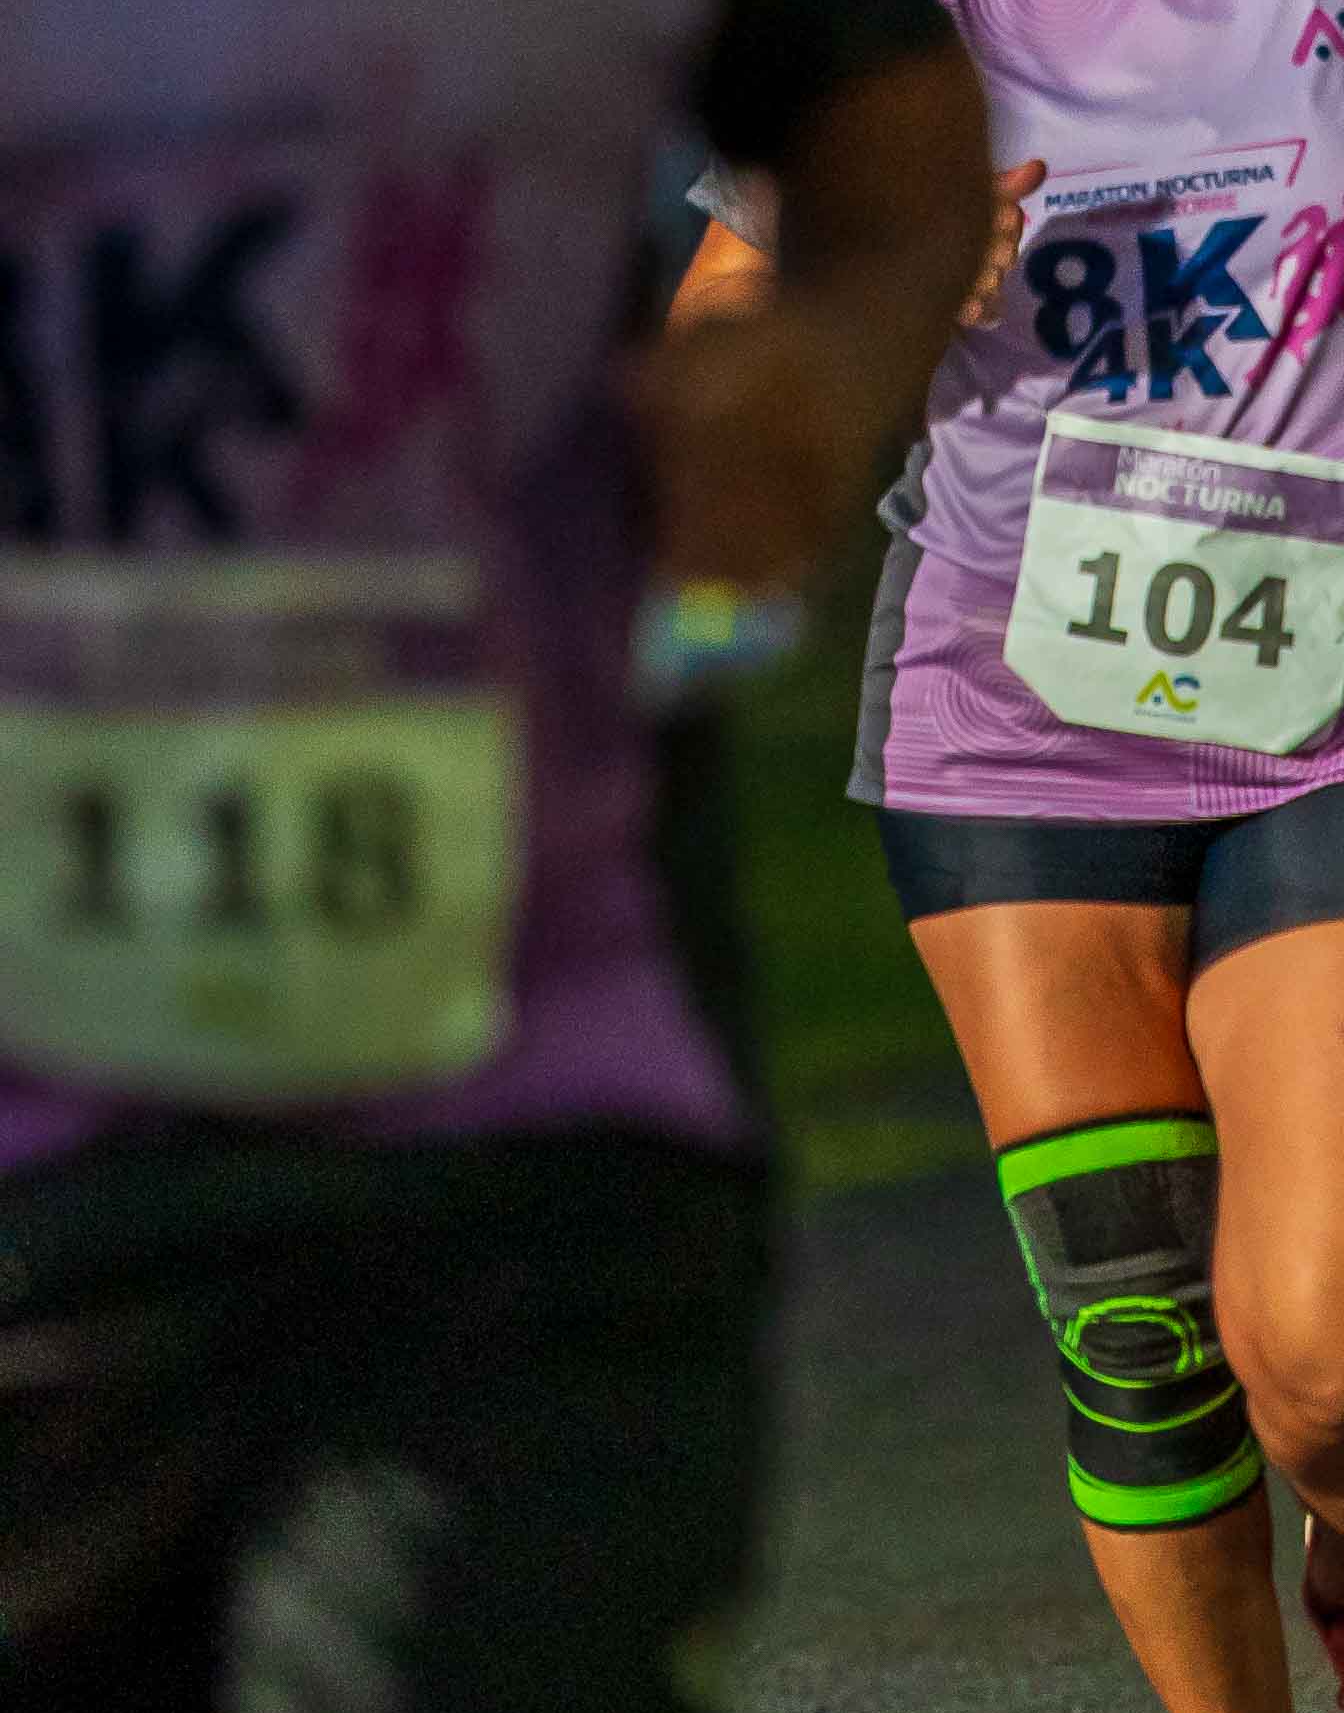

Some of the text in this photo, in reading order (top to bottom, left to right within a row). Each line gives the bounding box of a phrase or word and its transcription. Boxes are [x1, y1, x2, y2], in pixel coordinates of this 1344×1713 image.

[1024, 212, 1273, 361] 8K
[1067, 310, 1234, 403] 4K
[1114, 473, 1286, 520] NOCTURNA
[1067, 551, 1295, 668] 104
